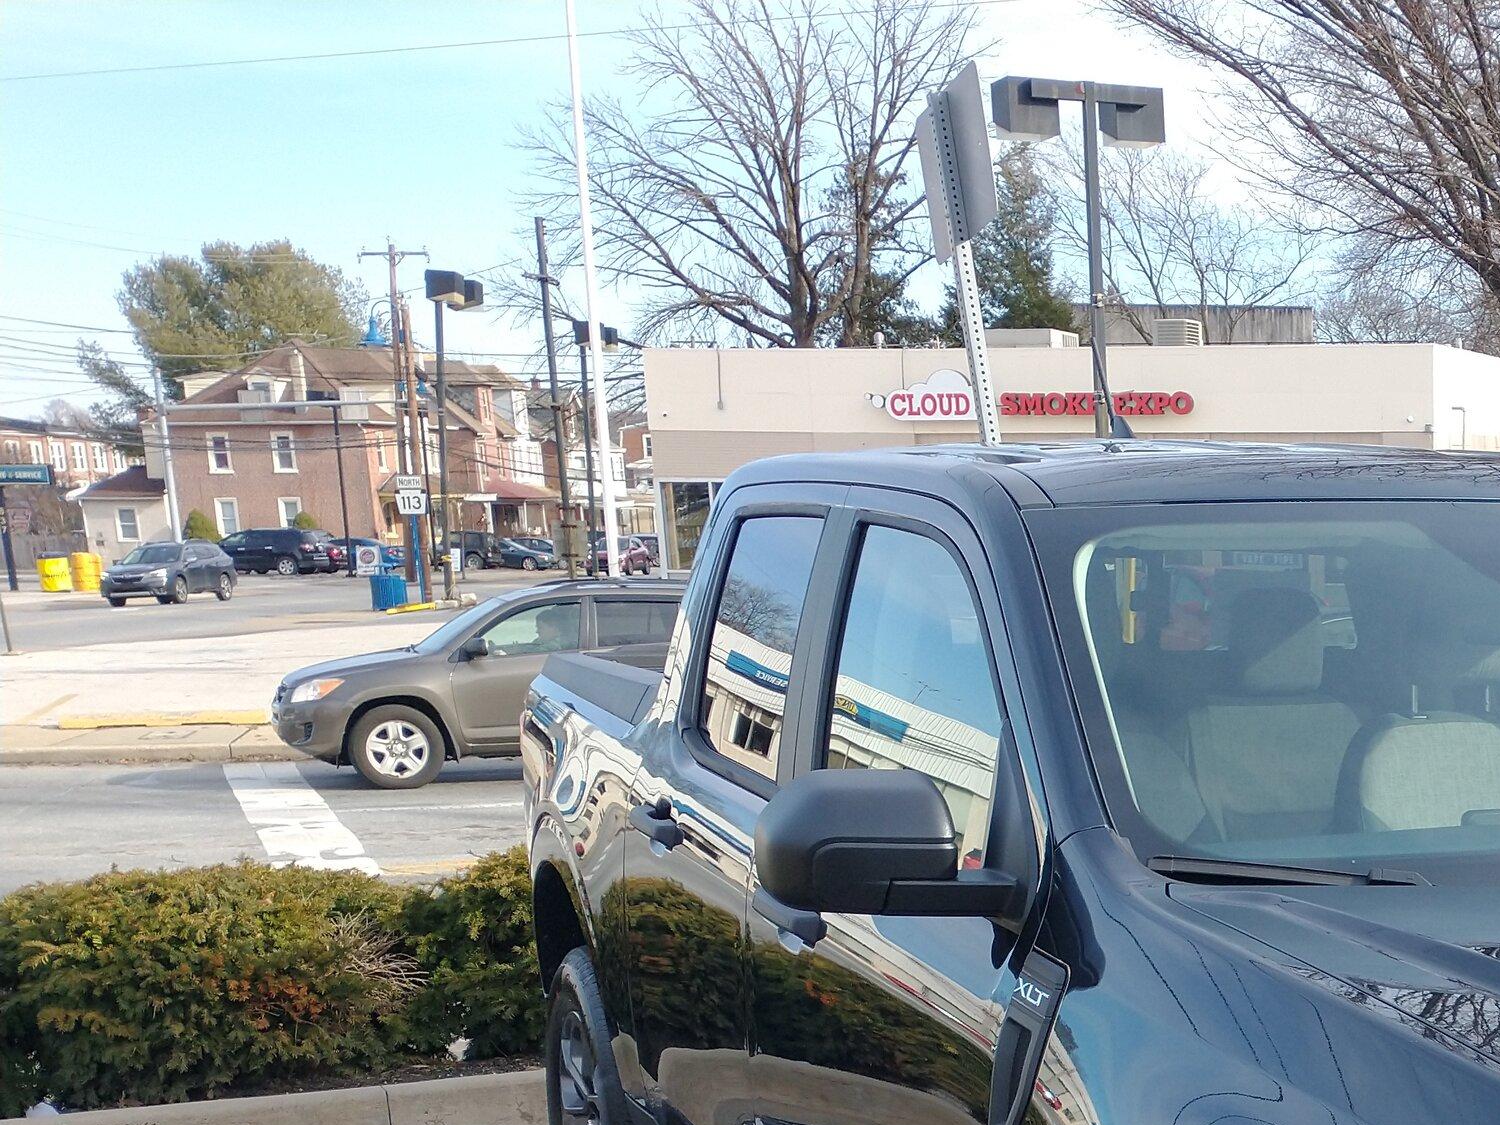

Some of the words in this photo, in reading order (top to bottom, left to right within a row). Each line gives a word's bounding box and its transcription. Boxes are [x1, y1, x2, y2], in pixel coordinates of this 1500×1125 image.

[890, 393, 970, 416] CLOUD
[1113, 391, 1194, 416] EXPO
[15, 470, 41, 480] SERVICE
[398, 478, 420, 487] NORTH
[401, 495, 422, 510] 113
[1013, 977, 1050, 1007] XLT
